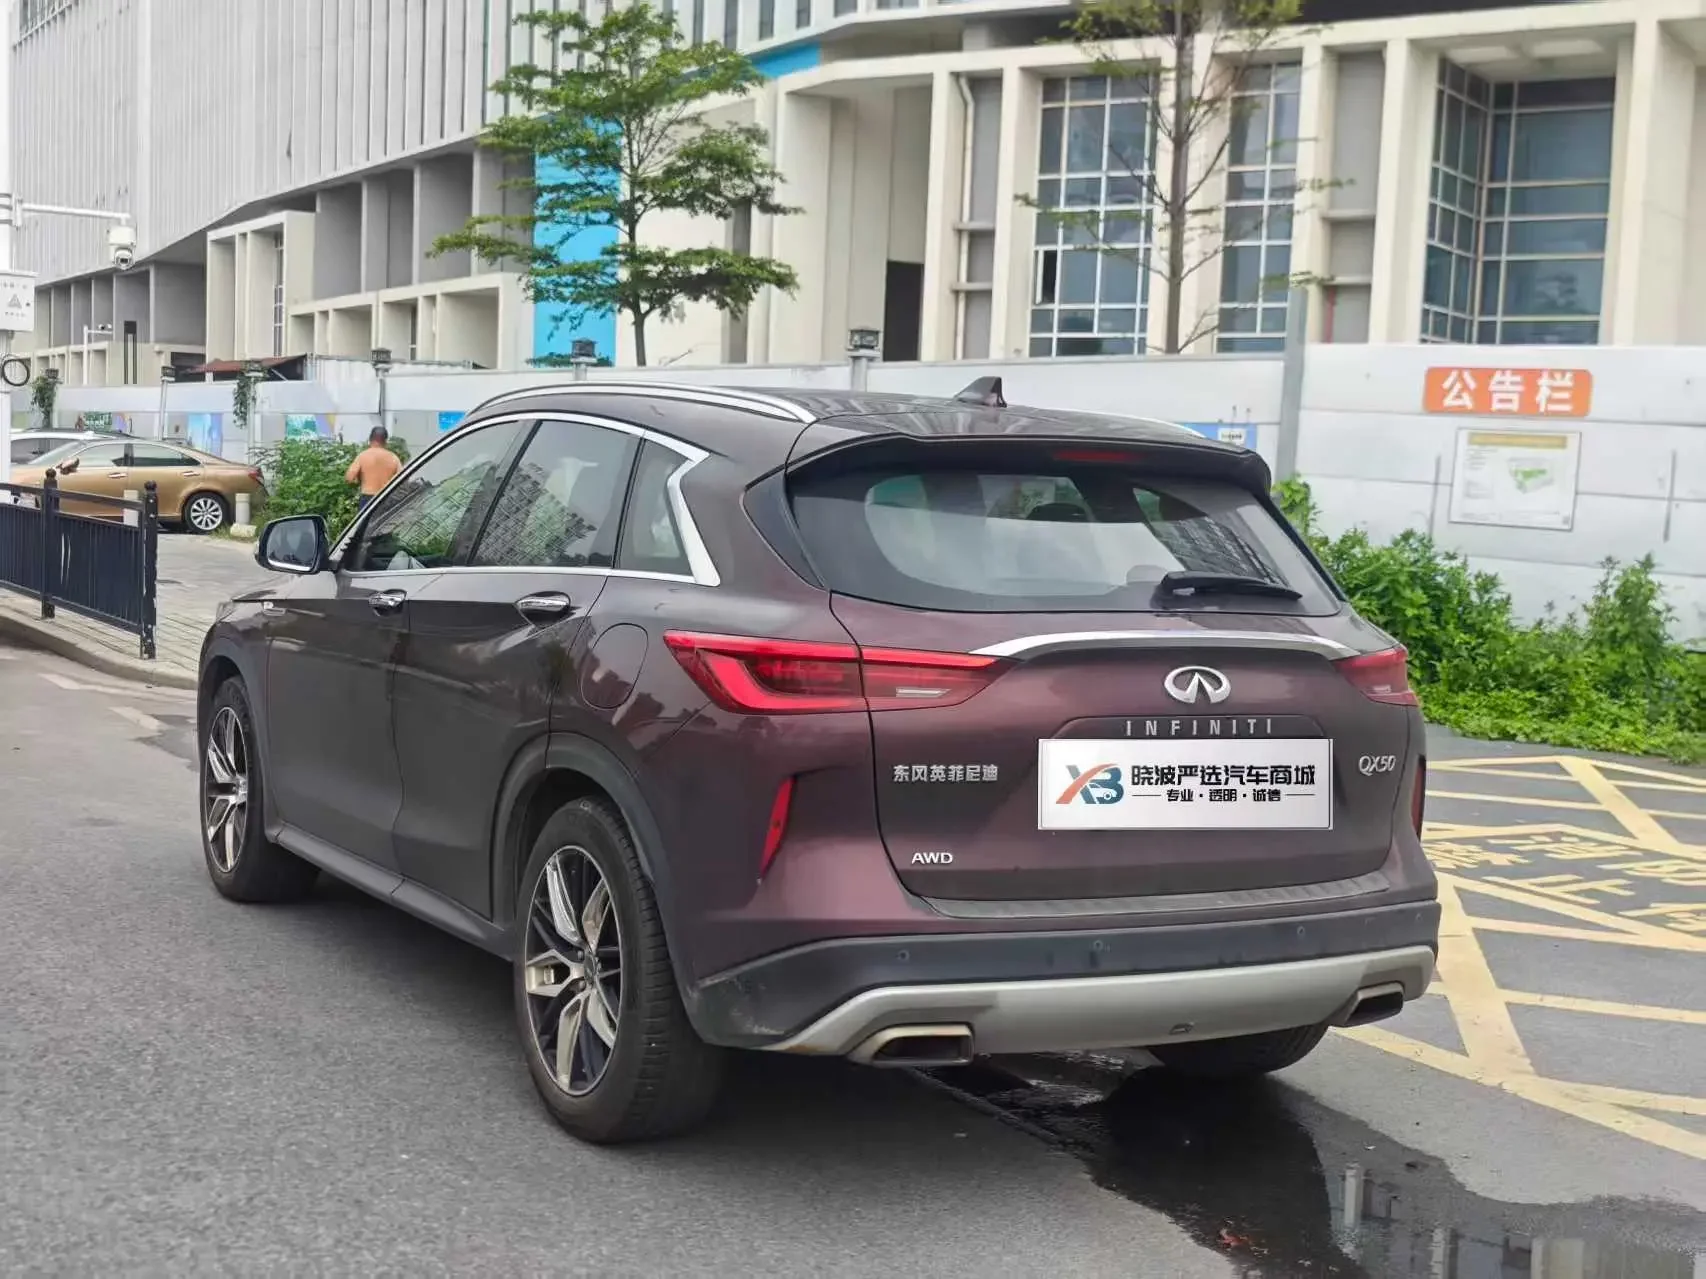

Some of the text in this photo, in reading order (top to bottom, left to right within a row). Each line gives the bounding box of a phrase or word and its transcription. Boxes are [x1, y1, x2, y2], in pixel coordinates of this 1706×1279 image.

[1441, 370, 1574, 413] 公告栏
[1125, 718, 1272, 736] INFINITI
[893, 763, 998, 782] 东风英菲尼迪
[1358, 755, 1397, 777] QX50
[911, 851, 954, 865] AWD
